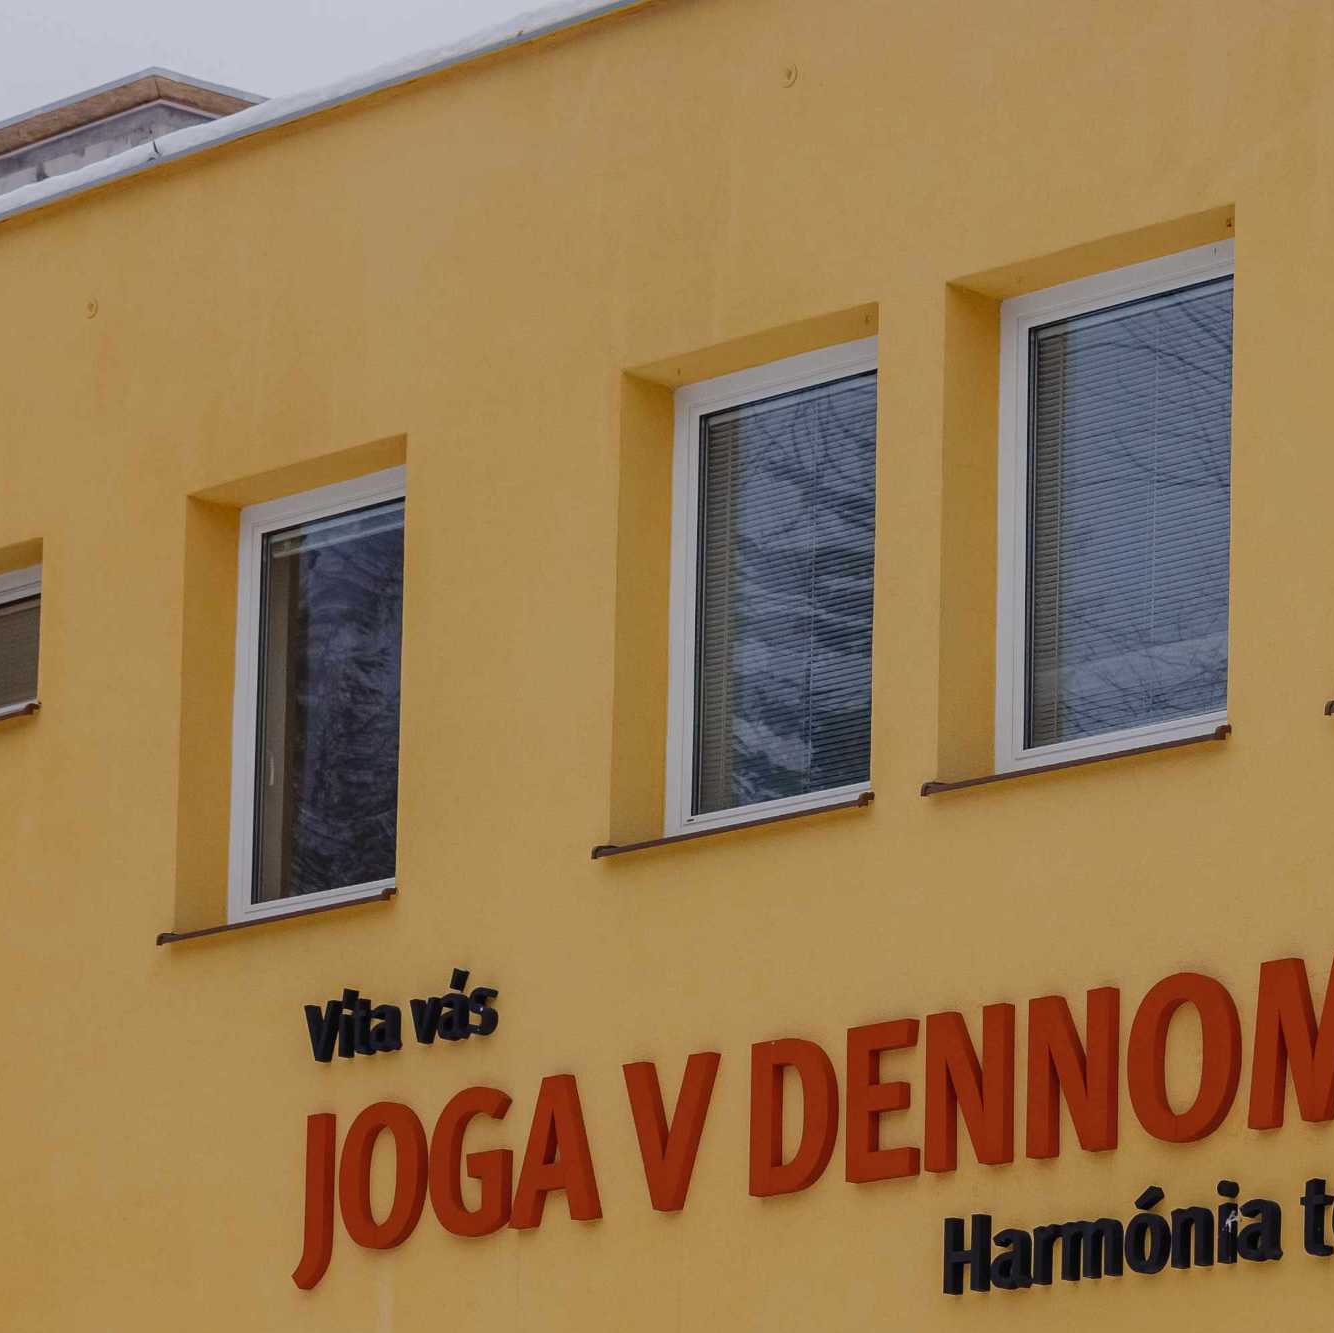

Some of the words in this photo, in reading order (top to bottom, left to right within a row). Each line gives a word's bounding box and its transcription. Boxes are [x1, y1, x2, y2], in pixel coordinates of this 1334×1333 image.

[410, 968, 499, 1044] vás
[291, 1073, 603, 1290] JOGA
[622, 1052, 722, 1213] V
[943, 1180, 1284, 1296] Harmónia
